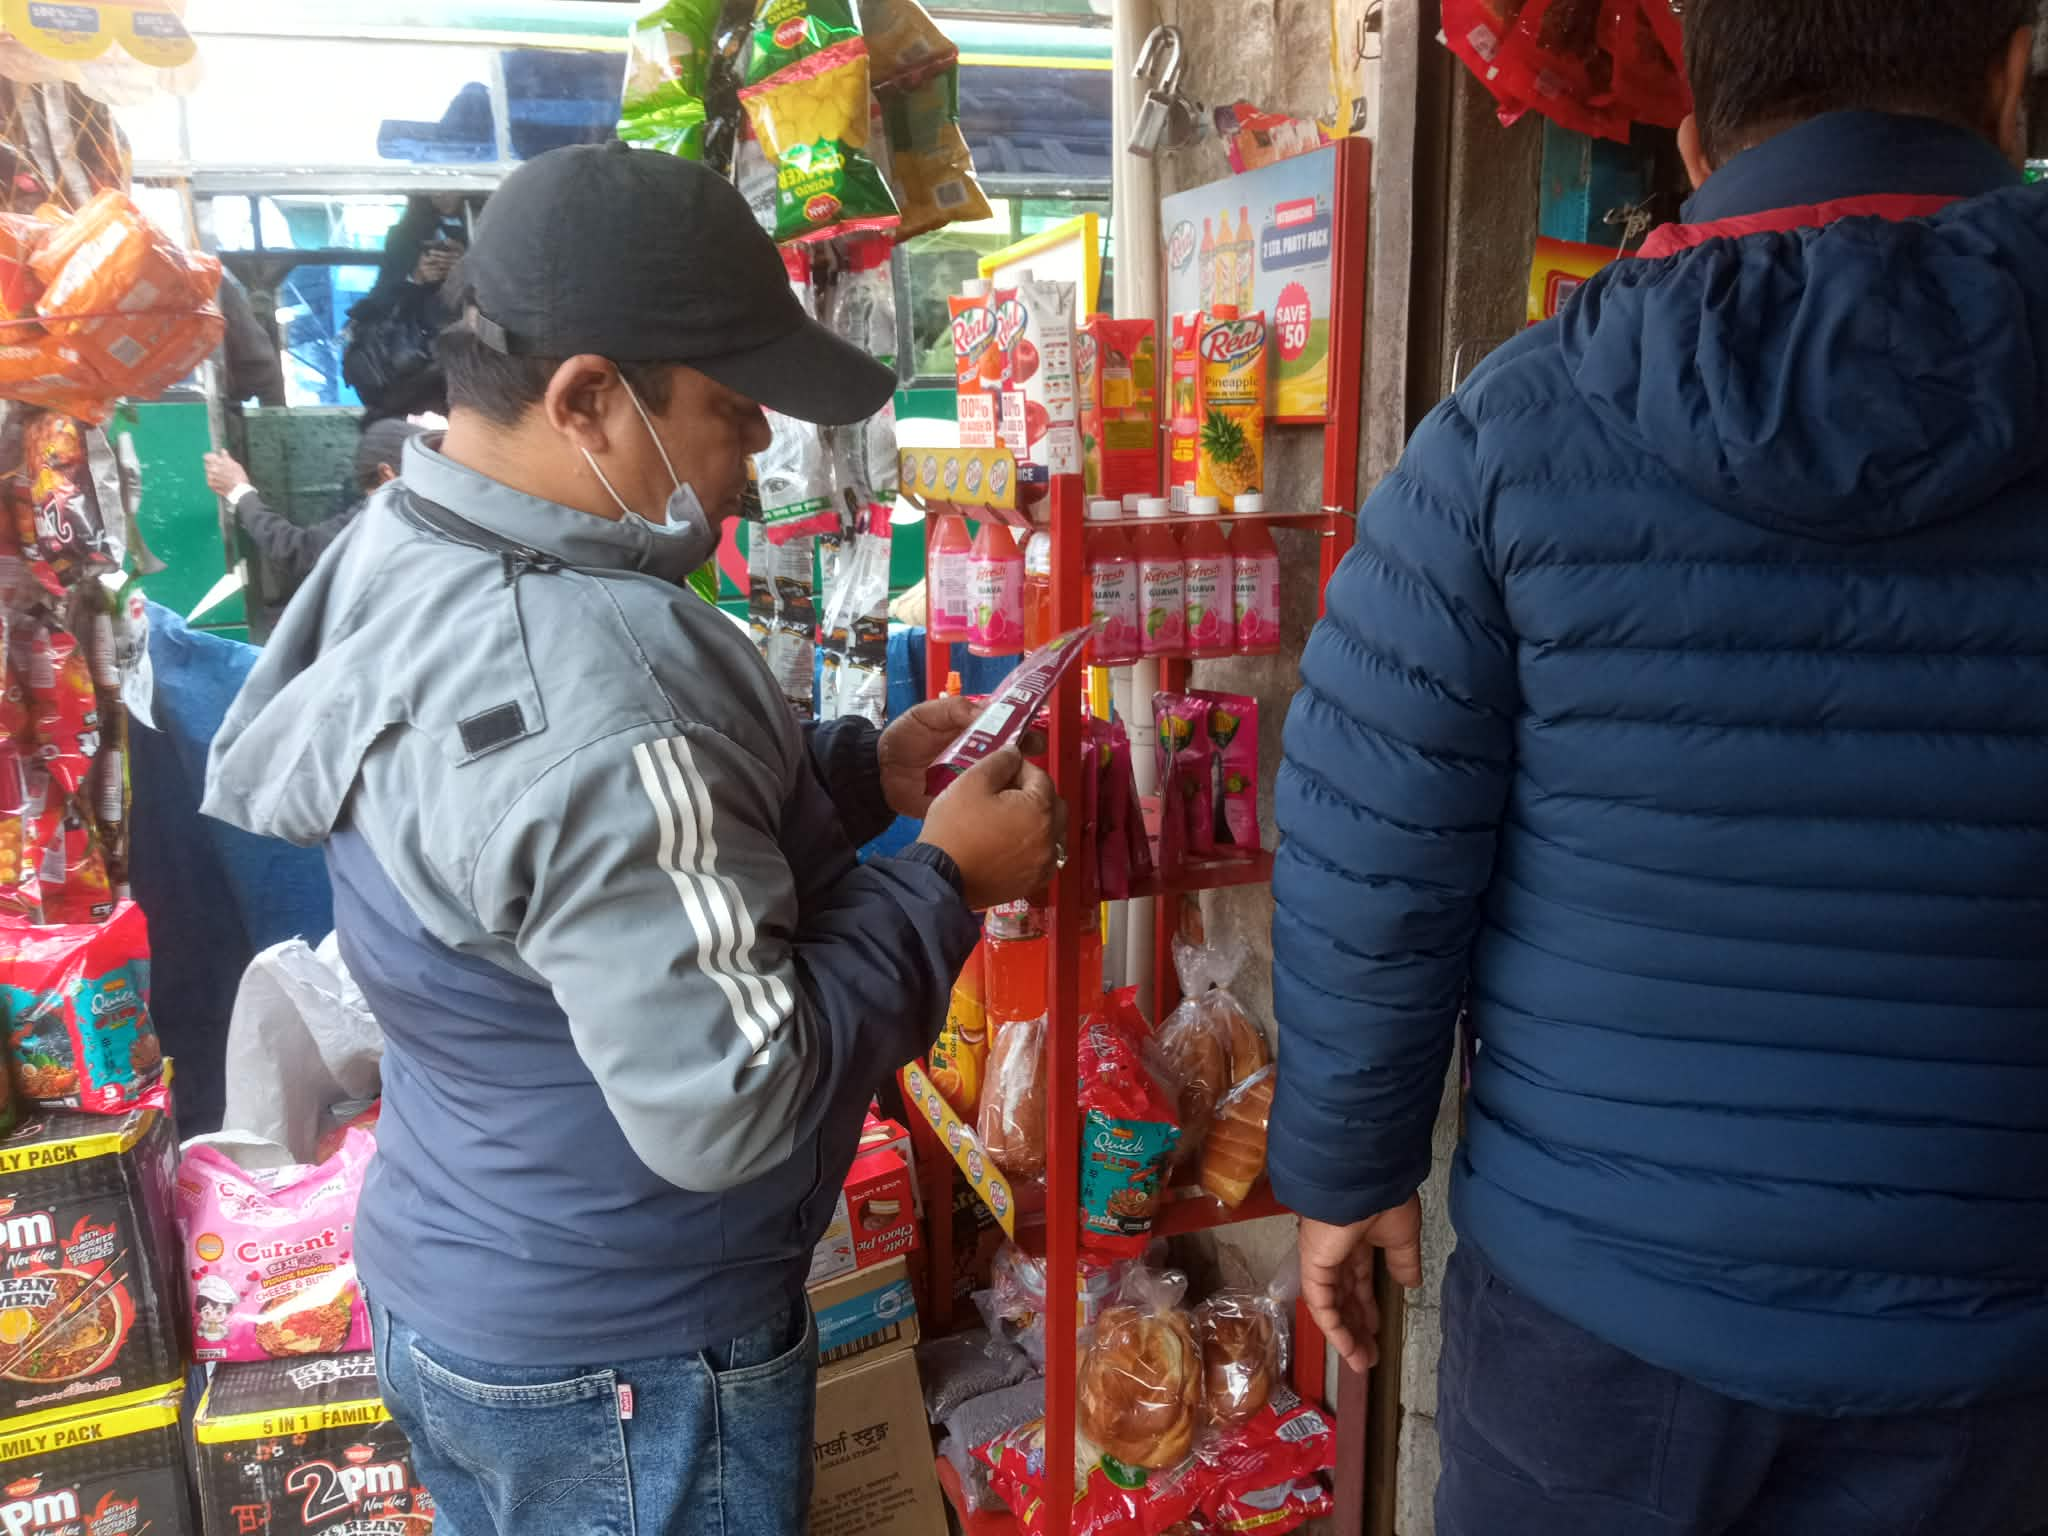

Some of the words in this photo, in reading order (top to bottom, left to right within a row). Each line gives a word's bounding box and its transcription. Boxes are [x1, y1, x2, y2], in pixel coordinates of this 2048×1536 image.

[778, 153, 845, 189] CKER
[1283, 231, 1307, 256] PARTY
[1308, 228, 1329, 249] PACK
[1276, 304, 1307, 322] SAVE
[953, 312, 989, 353] Real
[1285, 324, 1307, 349] 50
[1207, 326, 1259, 364] Real
[1205, 375, 1258, 389] Pineapple
[1149, 588, 1179, 597] GUAVA
[104, 1085, 118, 1099] 5
[1094, 1131, 1144, 1155] Quick
[28, 1145, 77, 1171] PACK
[857, 1233, 877, 1251] Pie
[878, 1223, 914, 1244] Choco
[883, 1235, 914, 1253] Lotte
[7, 1248, 57, 1270] Noodles
[237, 1231, 336, 1263] Current
[0, 1278, 56, 1293] EAN
[255, 1282, 292, 1300] CHEESE
[295, 1280, 303, 1289] &
[262, 1421, 273, 1435] 5
[279, 1418, 295, 1433] IN
[302, 1415, 310, 1430] 1
[322, 1405, 382, 1425] FAMILY
[0, 1434, 47, 1459] MILY
[54, 1423, 103, 1447] PACK
[287, 1460, 405, 1525] 2pm
[0, 1491, 77, 1536] pm
